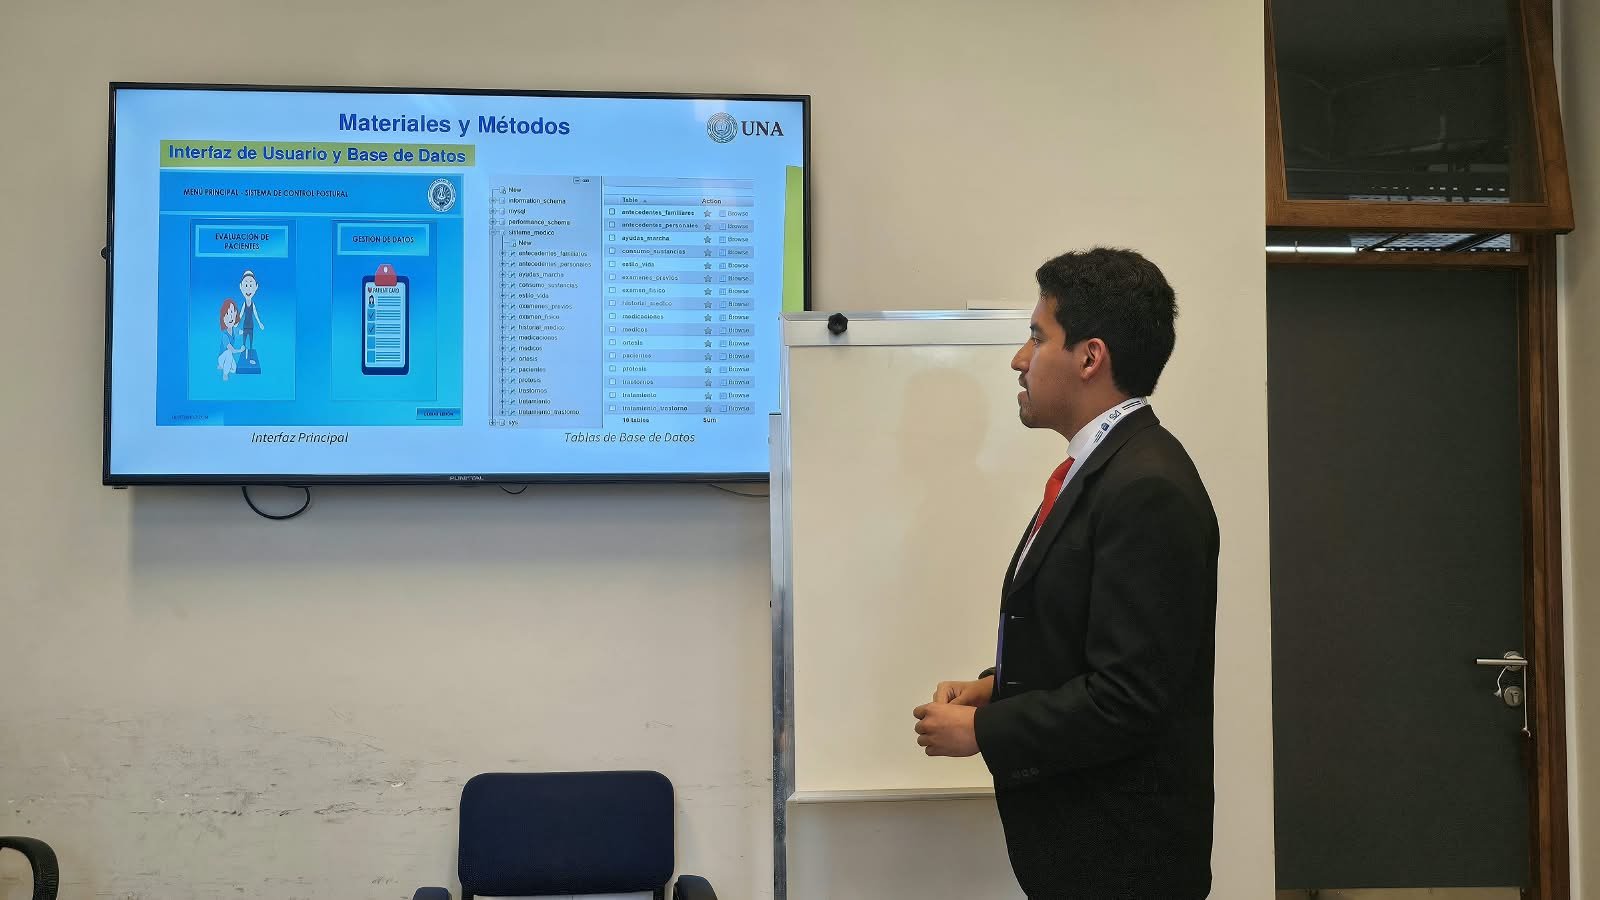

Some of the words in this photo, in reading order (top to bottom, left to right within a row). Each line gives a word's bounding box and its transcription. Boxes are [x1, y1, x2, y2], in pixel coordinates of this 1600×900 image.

[339, 113, 451, 133] Materiales
[458, 118, 471, 137] y
[477, 115, 571, 136] Métodos
[741, 120, 784, 137] UNA
[168, 144, 232, 160] Interfaz
[236, 146, 257, 160] de
[263, 145, 328, 161] Usuario
[333, 149, 342, 164] y
[347, 147, 388, 162] Base
[393, 147, 414, 162] de
[418, 148, 466, 163] Datos
[183, 187, 203, 196] MENÚ
[204, 188, 239, 197] PRINCIPAL
[245, 189, 272, 197] SISTEMA
[273, 189, 282, 197] DE
[283, 189, 315, 198] CONTROL
[316, 190, 348, 198] POSTURAL
[215, 231, 260, 241] EVALUACIÓN
[261, 233, 270, 241] DE
[352, 234, 381, 243] GESTIÓN
[382, 235, 393, 243] DE
[393, 235, 415, 244] DATOS
[224, 242, 260, 250] PACIENTES
[251, 431, 296, 443] Interfaz
[298, 431, 349, 445] Principal
[564, 432, 601, 443] Tablas
[603, 432, 616, 443] de
[619, 432, 646, 443] Base
[648, 432, 662, 443] de
[664, 432, 696, 443] Datos
